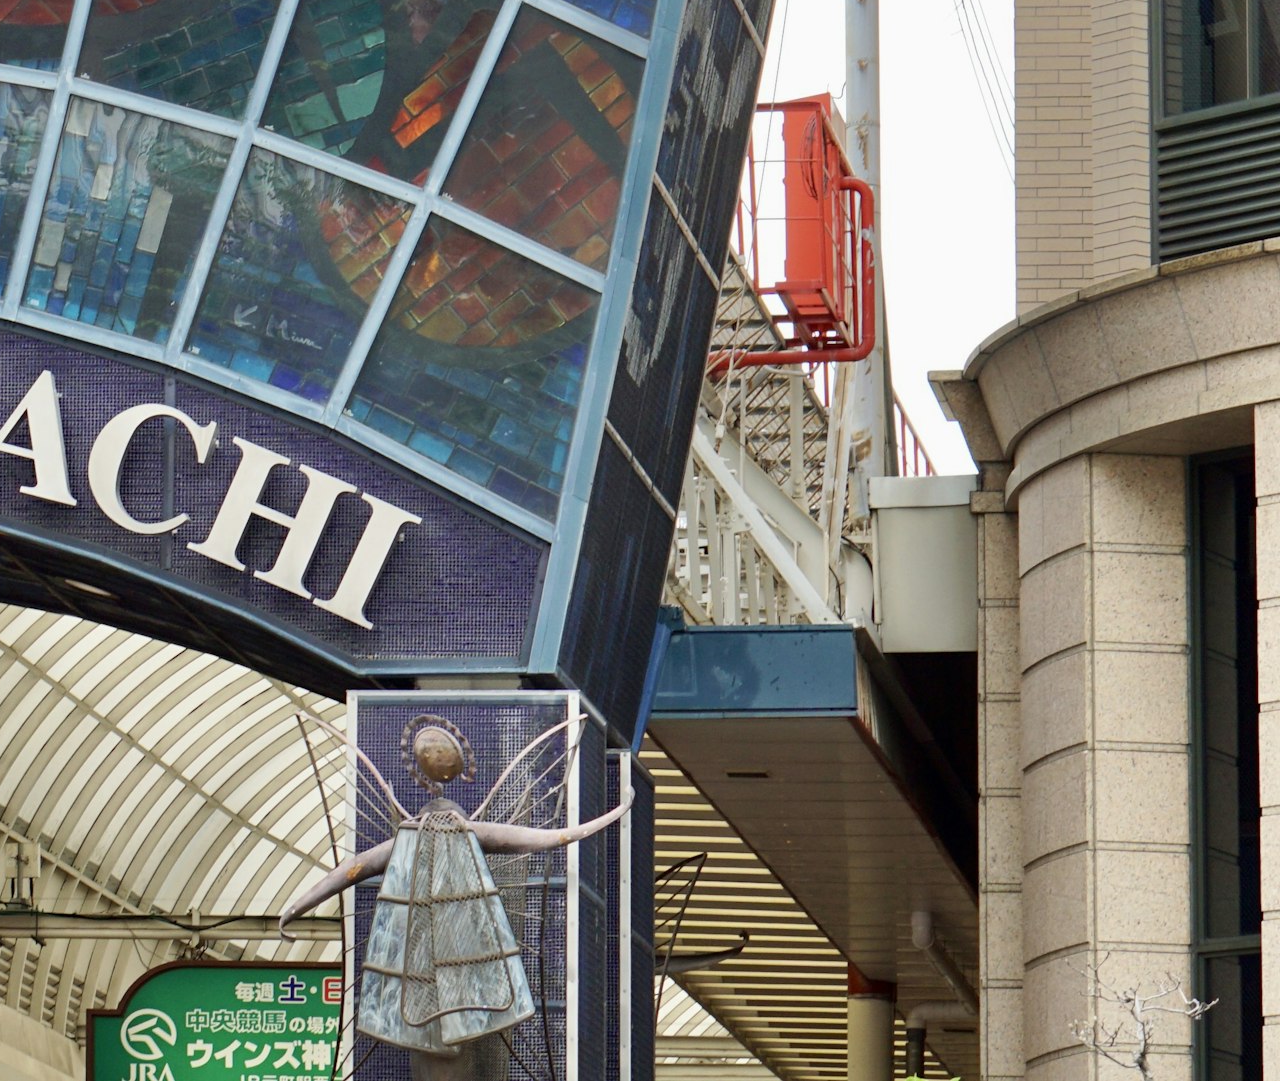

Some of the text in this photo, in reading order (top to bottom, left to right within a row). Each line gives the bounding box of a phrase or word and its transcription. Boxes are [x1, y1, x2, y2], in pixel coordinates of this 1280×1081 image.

[187, 1039, 342, 1071] ウインズ神
